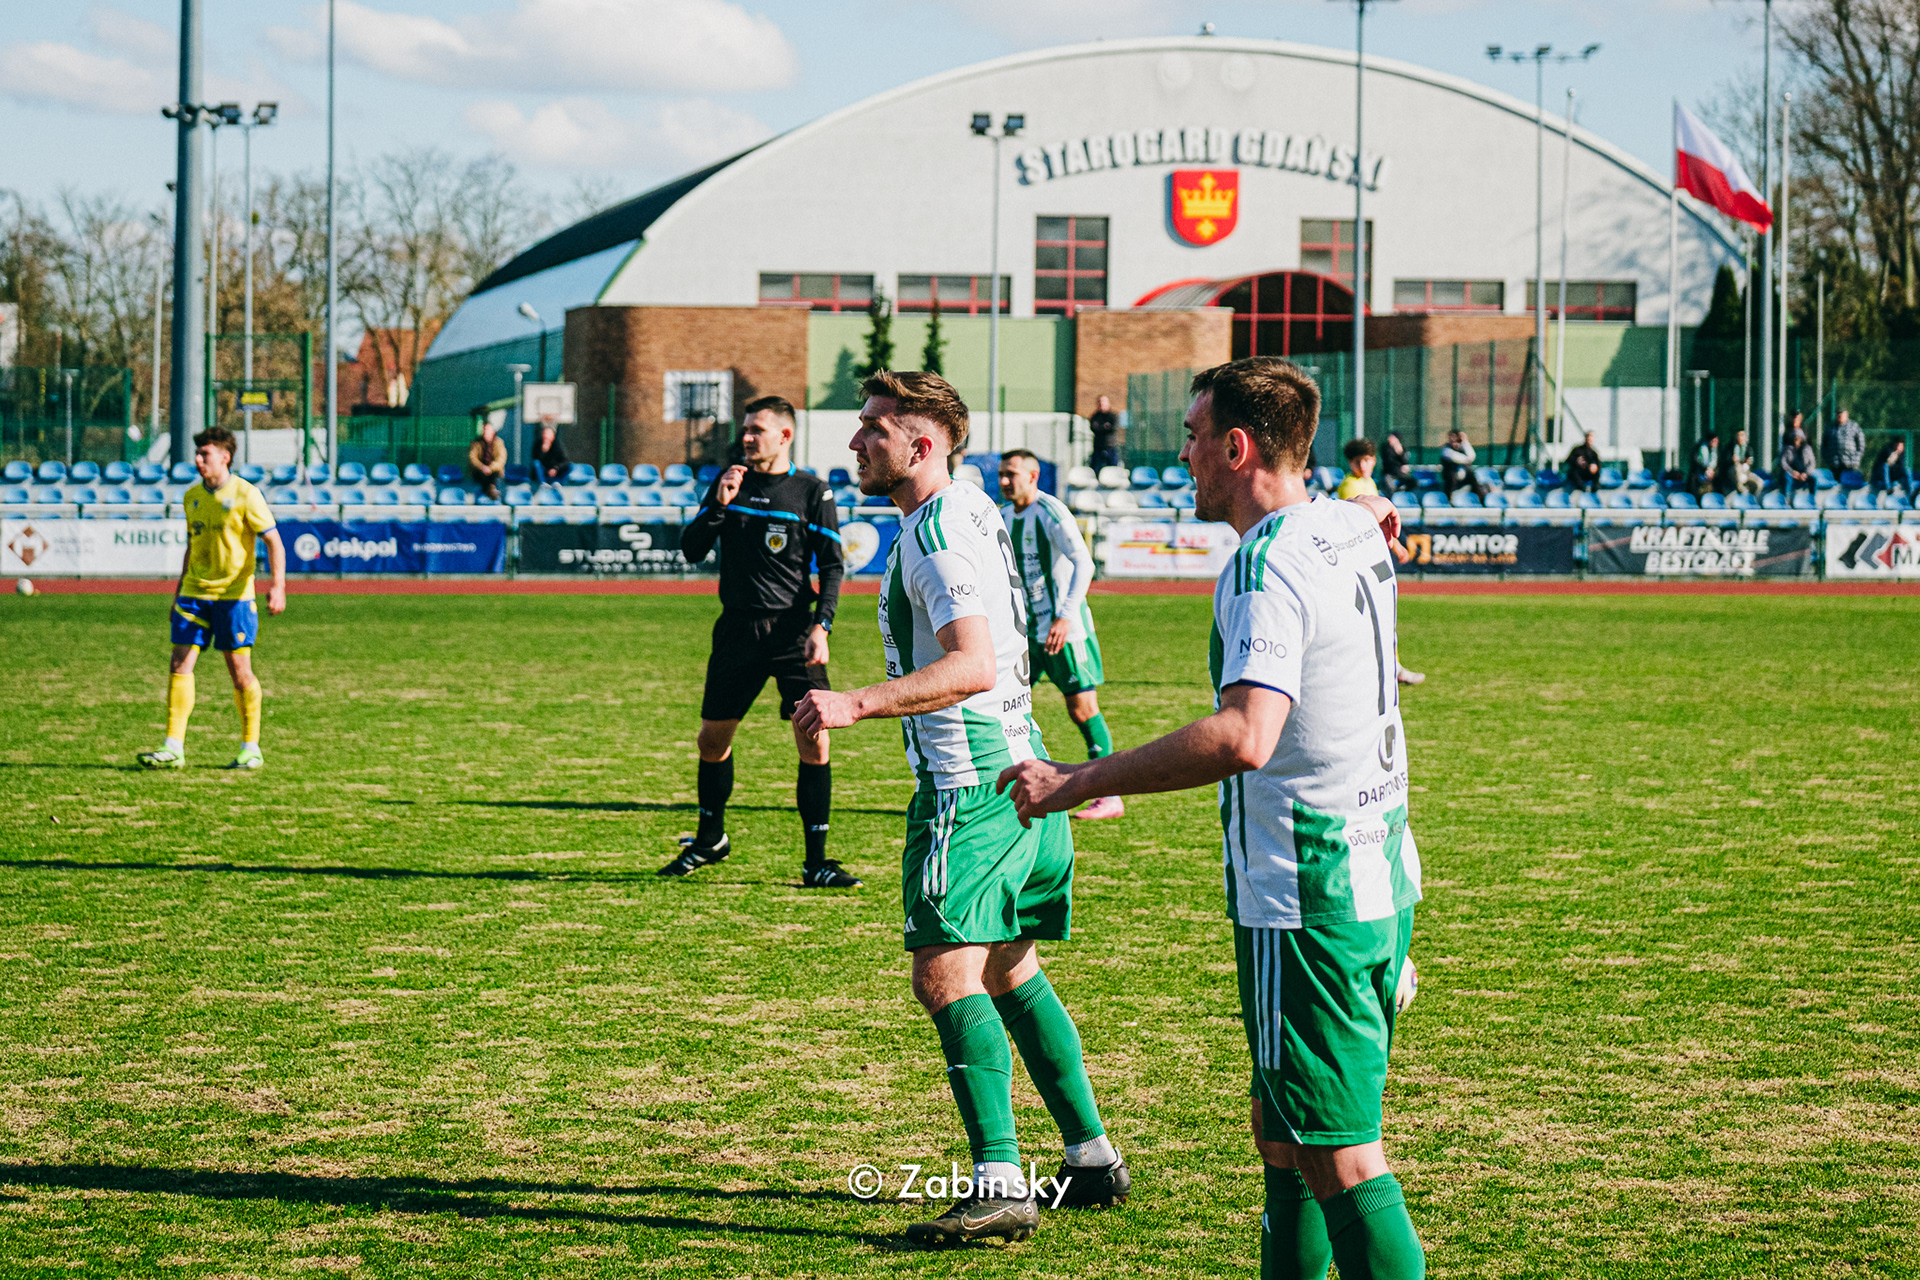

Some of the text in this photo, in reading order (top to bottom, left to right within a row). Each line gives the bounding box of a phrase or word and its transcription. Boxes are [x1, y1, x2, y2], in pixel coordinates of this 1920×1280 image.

[1016, 127, 1232, 185] STAROGARD
[324, 537, 396, 561] dekpol
[558, 549, 633, 564] STUDIO
[1240, 637, 1287, 659] NO10
